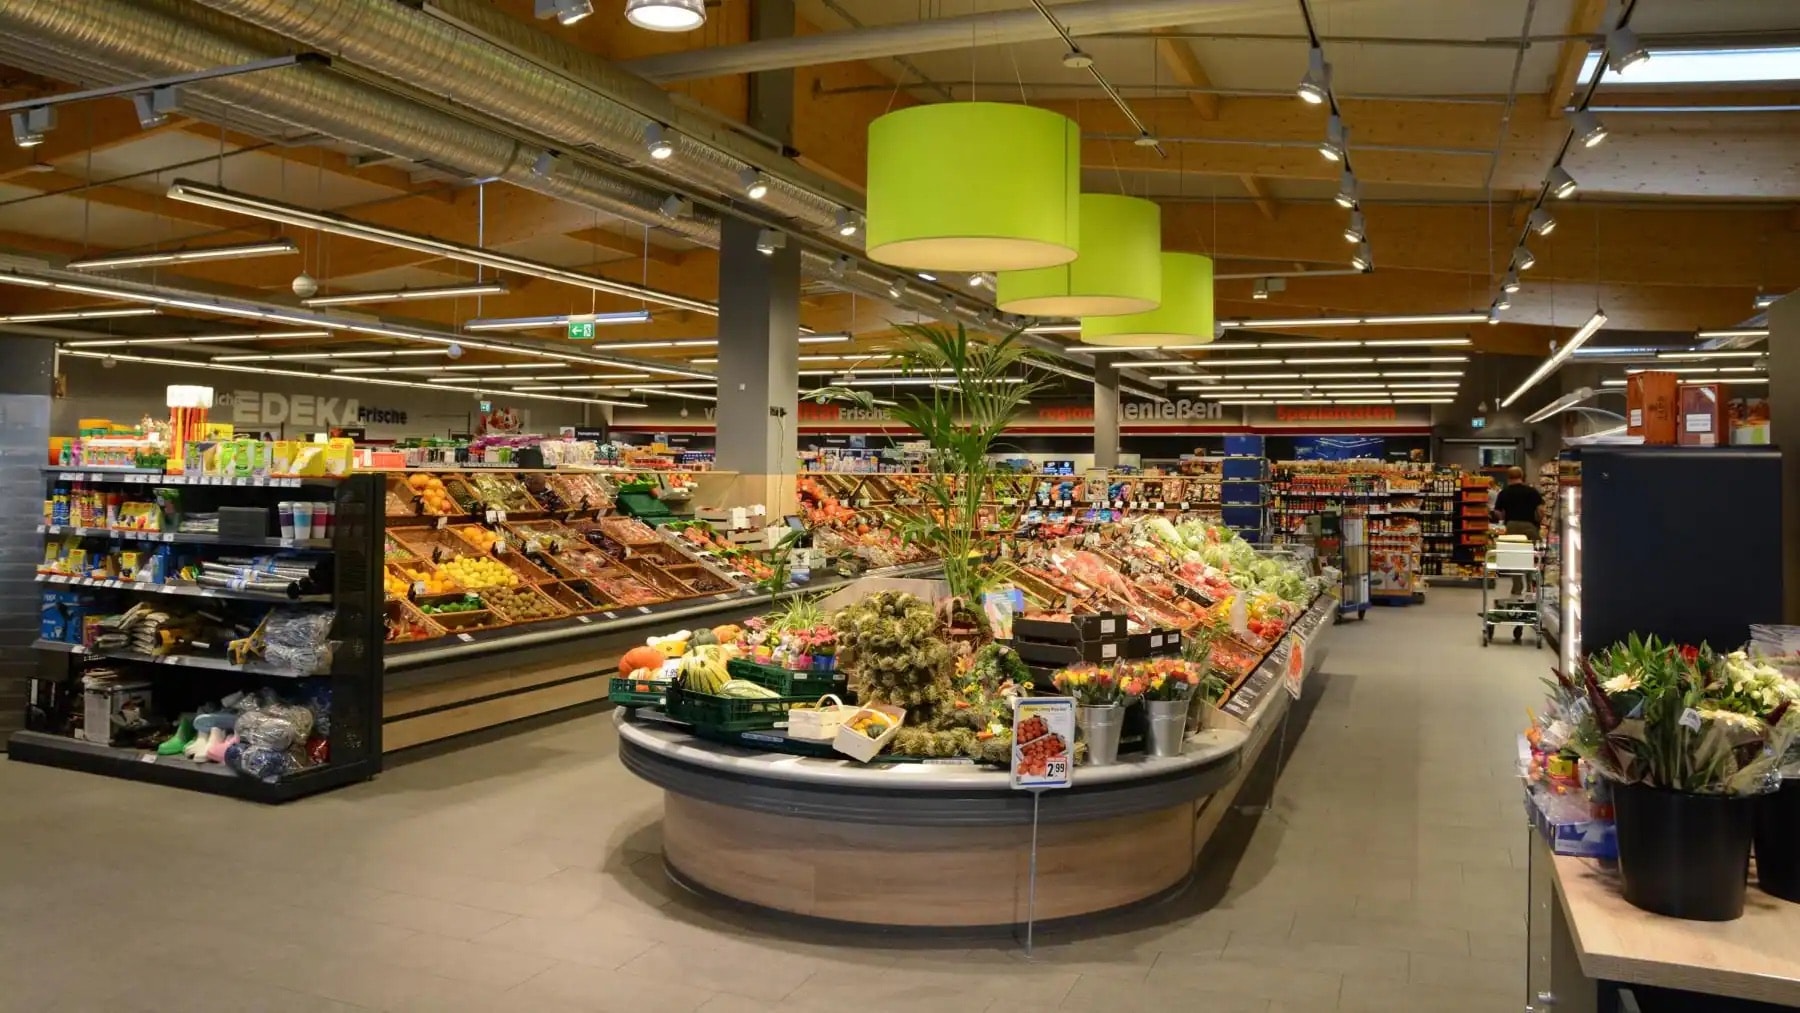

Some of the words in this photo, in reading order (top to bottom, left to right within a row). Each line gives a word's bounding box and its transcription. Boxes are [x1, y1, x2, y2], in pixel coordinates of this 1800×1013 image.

[233, 389, 363, 428] EDEKA
[358, 405, 408, 425] Frische
[838, 405, 892, 421] Frische
[1039, 405, 1094, 422] region
[1119, 399, 1222, 420] enießen
